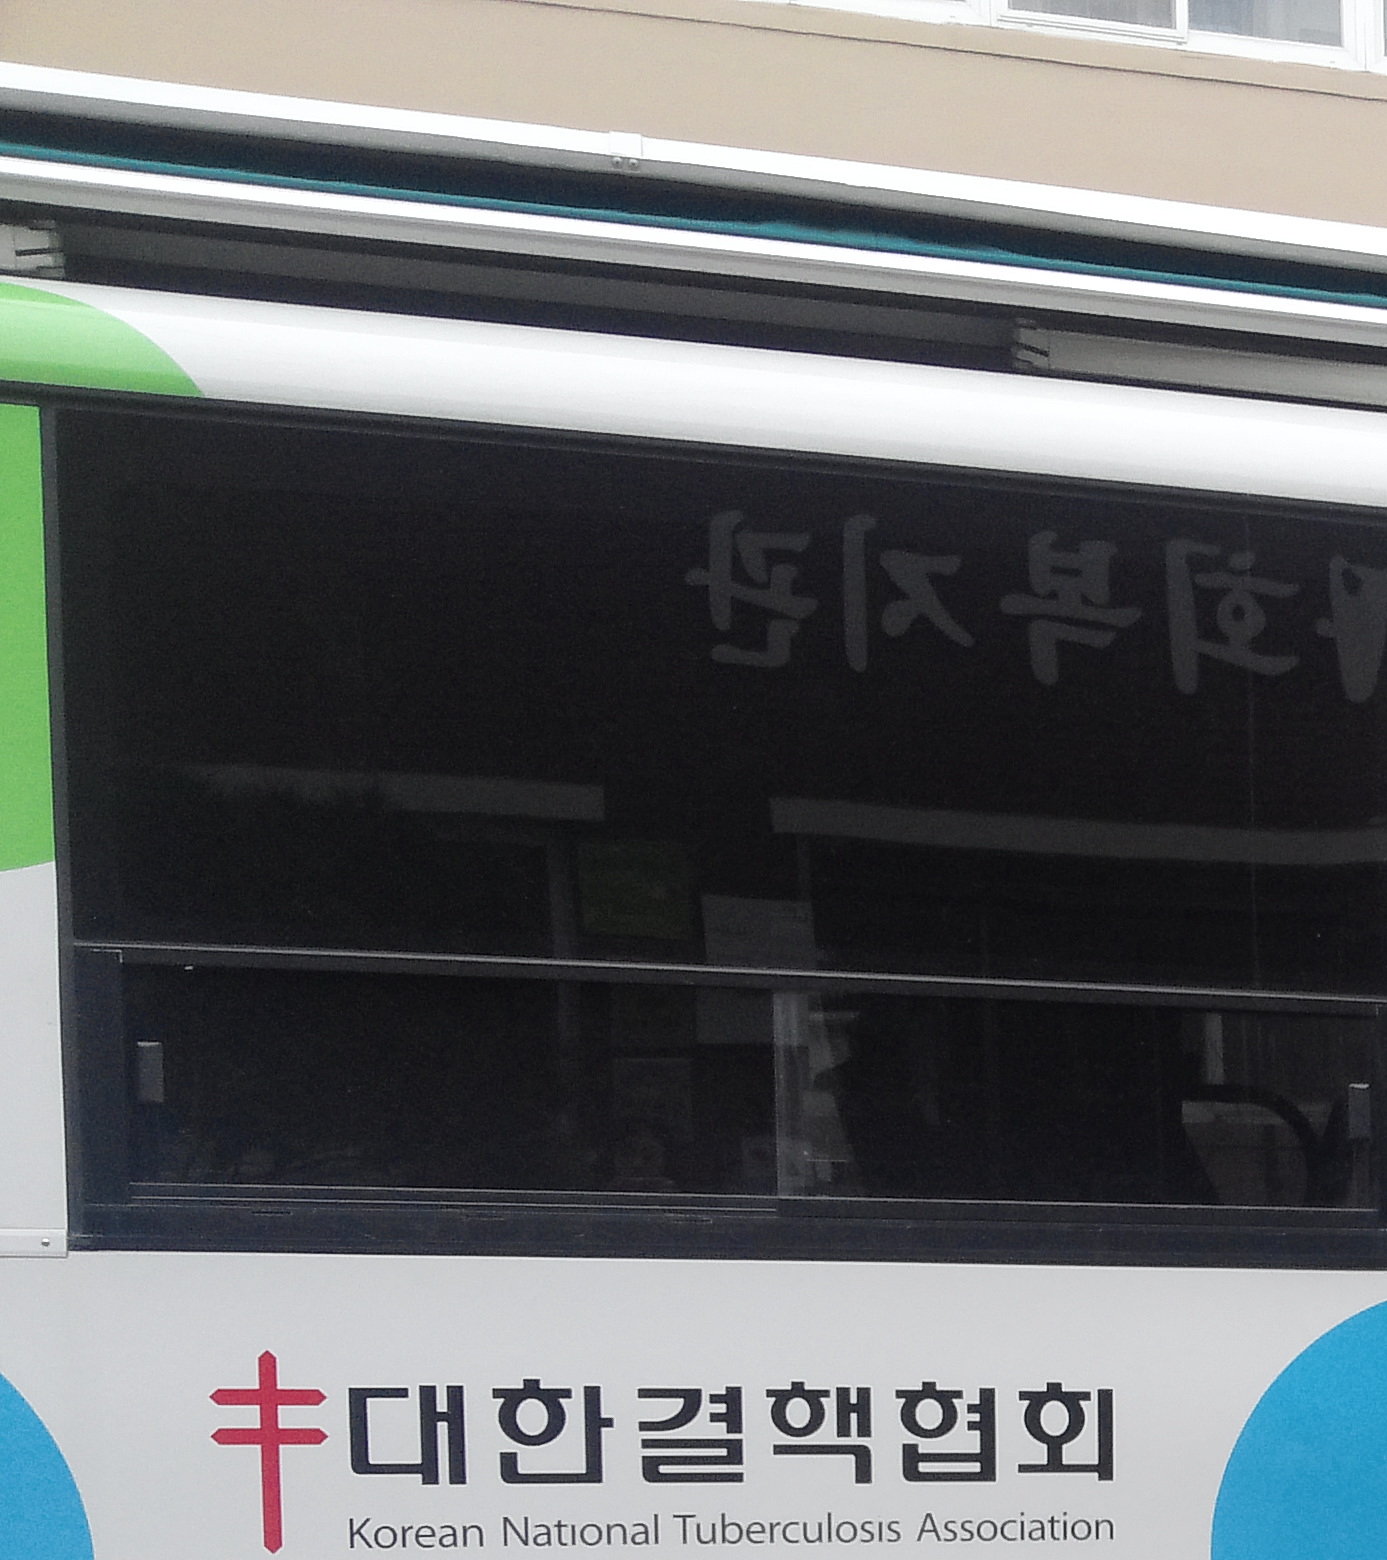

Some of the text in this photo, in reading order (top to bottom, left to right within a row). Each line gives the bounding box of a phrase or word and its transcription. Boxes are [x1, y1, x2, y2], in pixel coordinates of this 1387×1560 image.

[347, 1377, 1114, 1486] 대한결핵협회
[347, 1510, 1114, 1549] Korean National Tuberculosis Association
